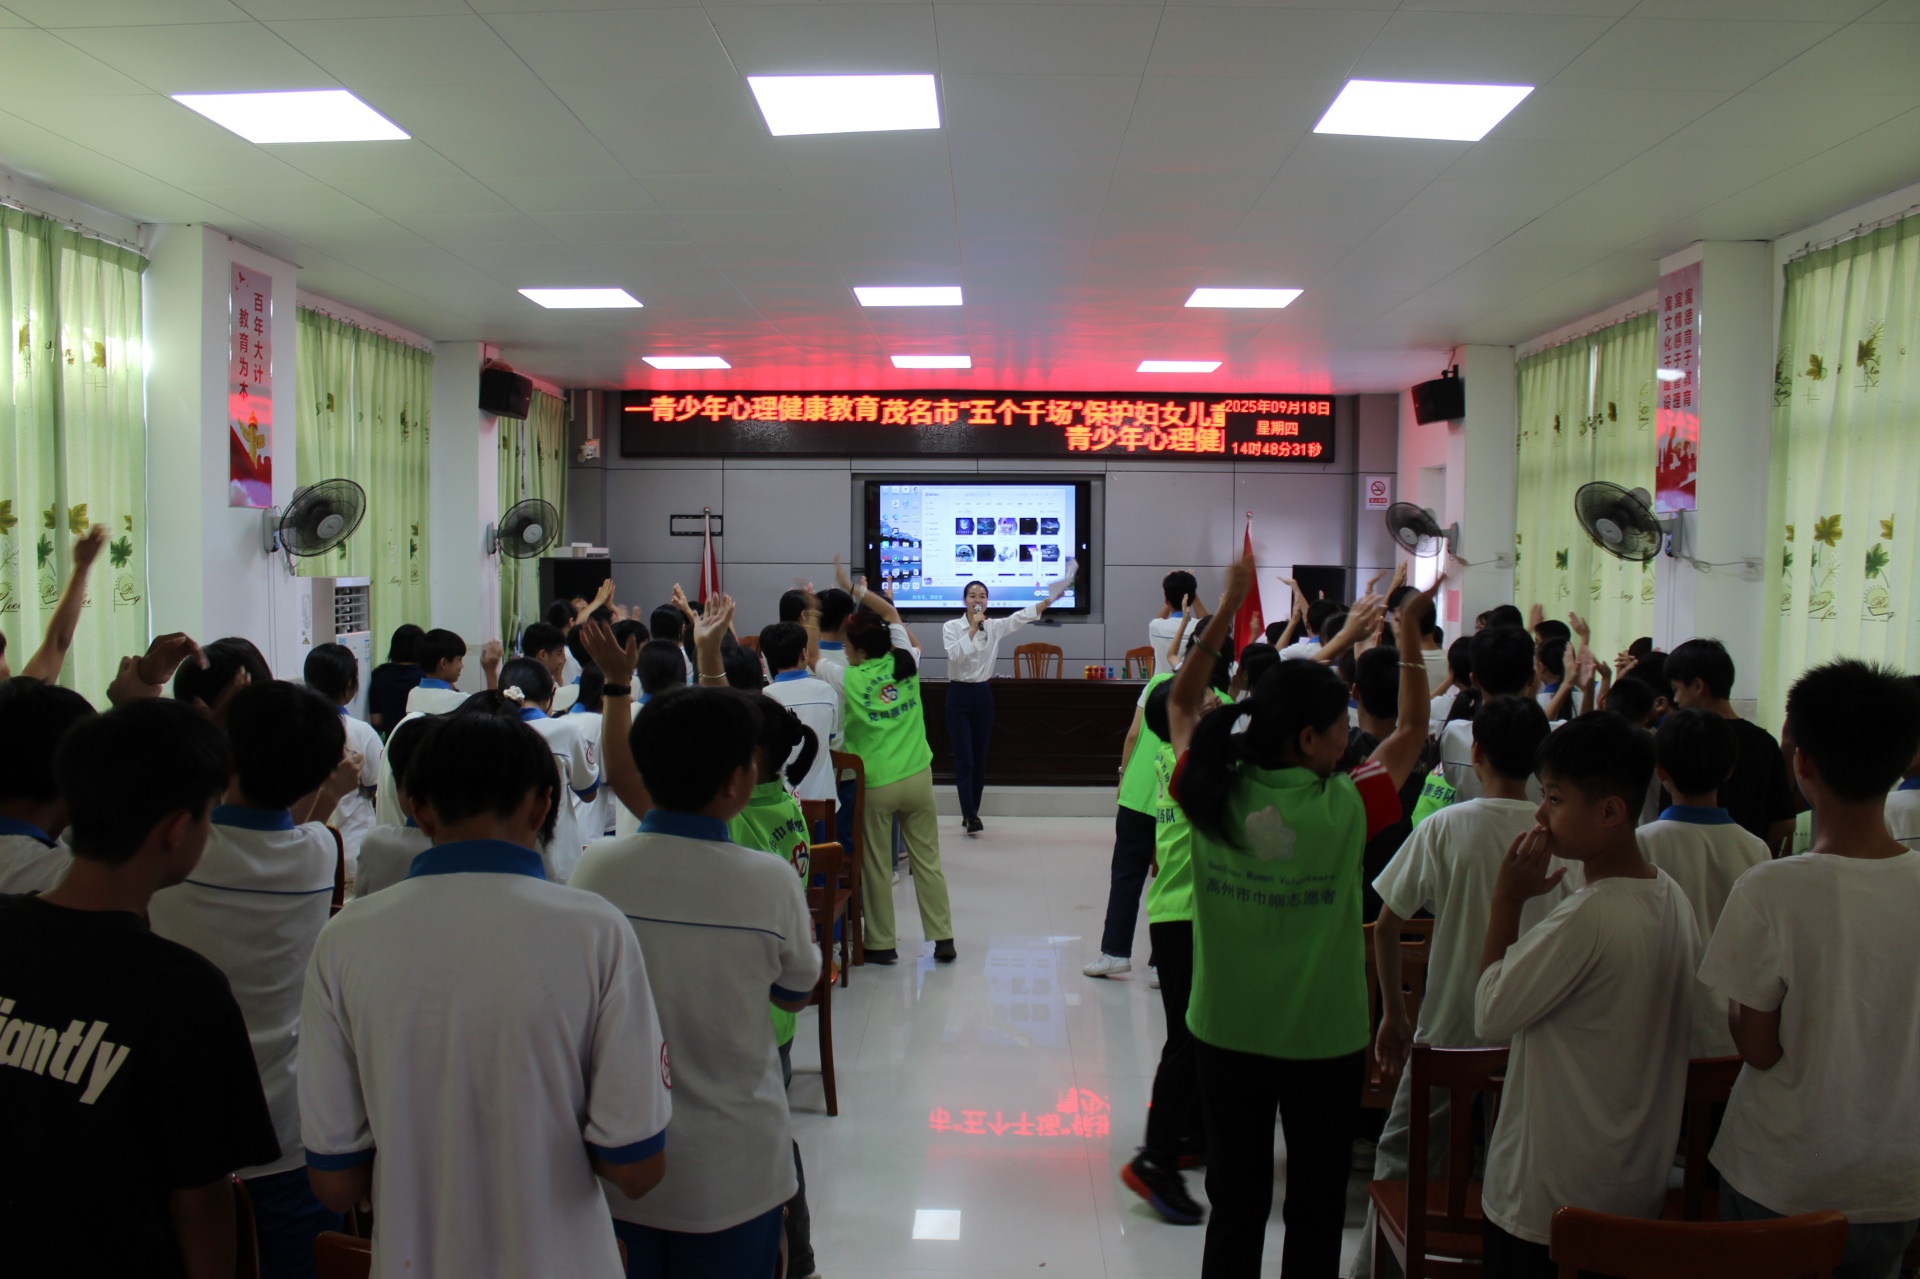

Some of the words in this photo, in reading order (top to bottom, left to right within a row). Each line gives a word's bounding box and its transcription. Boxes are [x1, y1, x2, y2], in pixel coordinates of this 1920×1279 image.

[253, 293, 264, 385] 百年大计
[239, 308, 249, 401] 教育为本
[1225, 399, 1331, 416] 2025年09月18日
[1066, 424, 1226, 453] 青少年心理健
[1256, 420, 1299, 436] 星期四
[1231, 441, 1323, 458] 14时48分31秒
[1246, 870, 1275, 883] Women
[1206, 876, 1337, 909] 高州市巾帼志愿者
[0, 997, 131, 1105] iantly
